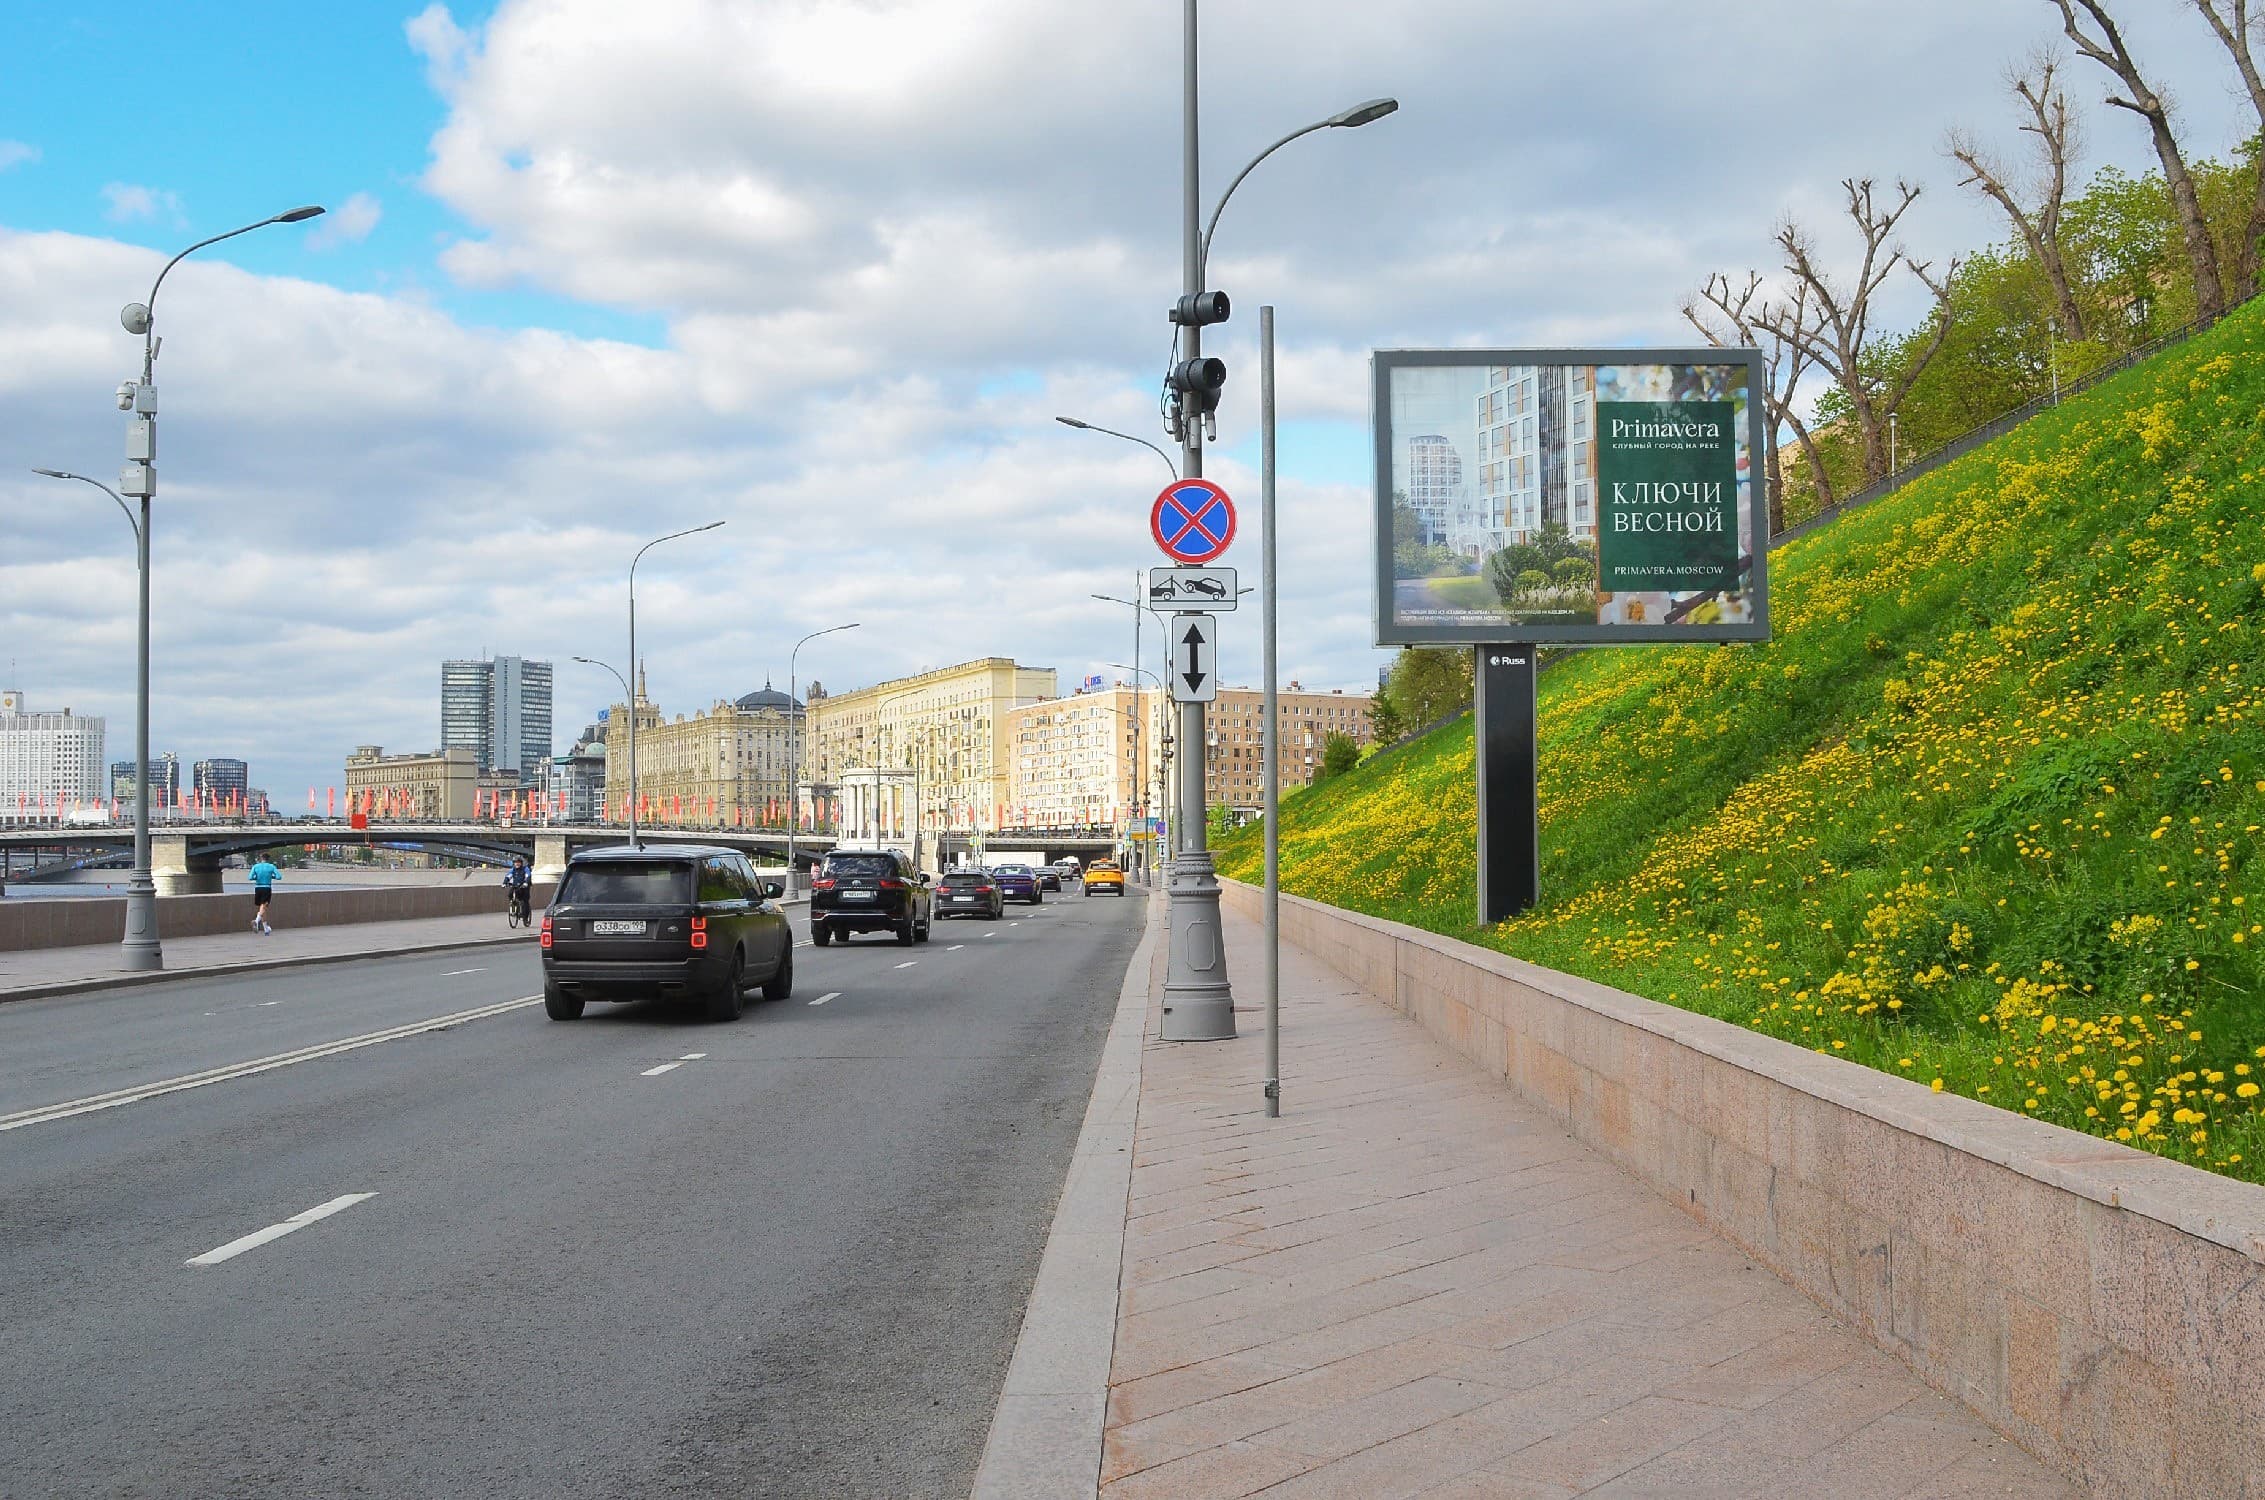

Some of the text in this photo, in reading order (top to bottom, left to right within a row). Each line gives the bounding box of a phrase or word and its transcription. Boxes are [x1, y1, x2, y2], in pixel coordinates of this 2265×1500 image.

[1611, 418, 1720, 438] Primavera
[1612, 482, 1722, 504] КЛЮЧИ
[1613, 506, 1724, 532] ВЕСНОЙ
[1614, 566, 1724, 575] PRIMAVERA.MOSCOW
[1501, 656, 1526, 665] Russ
